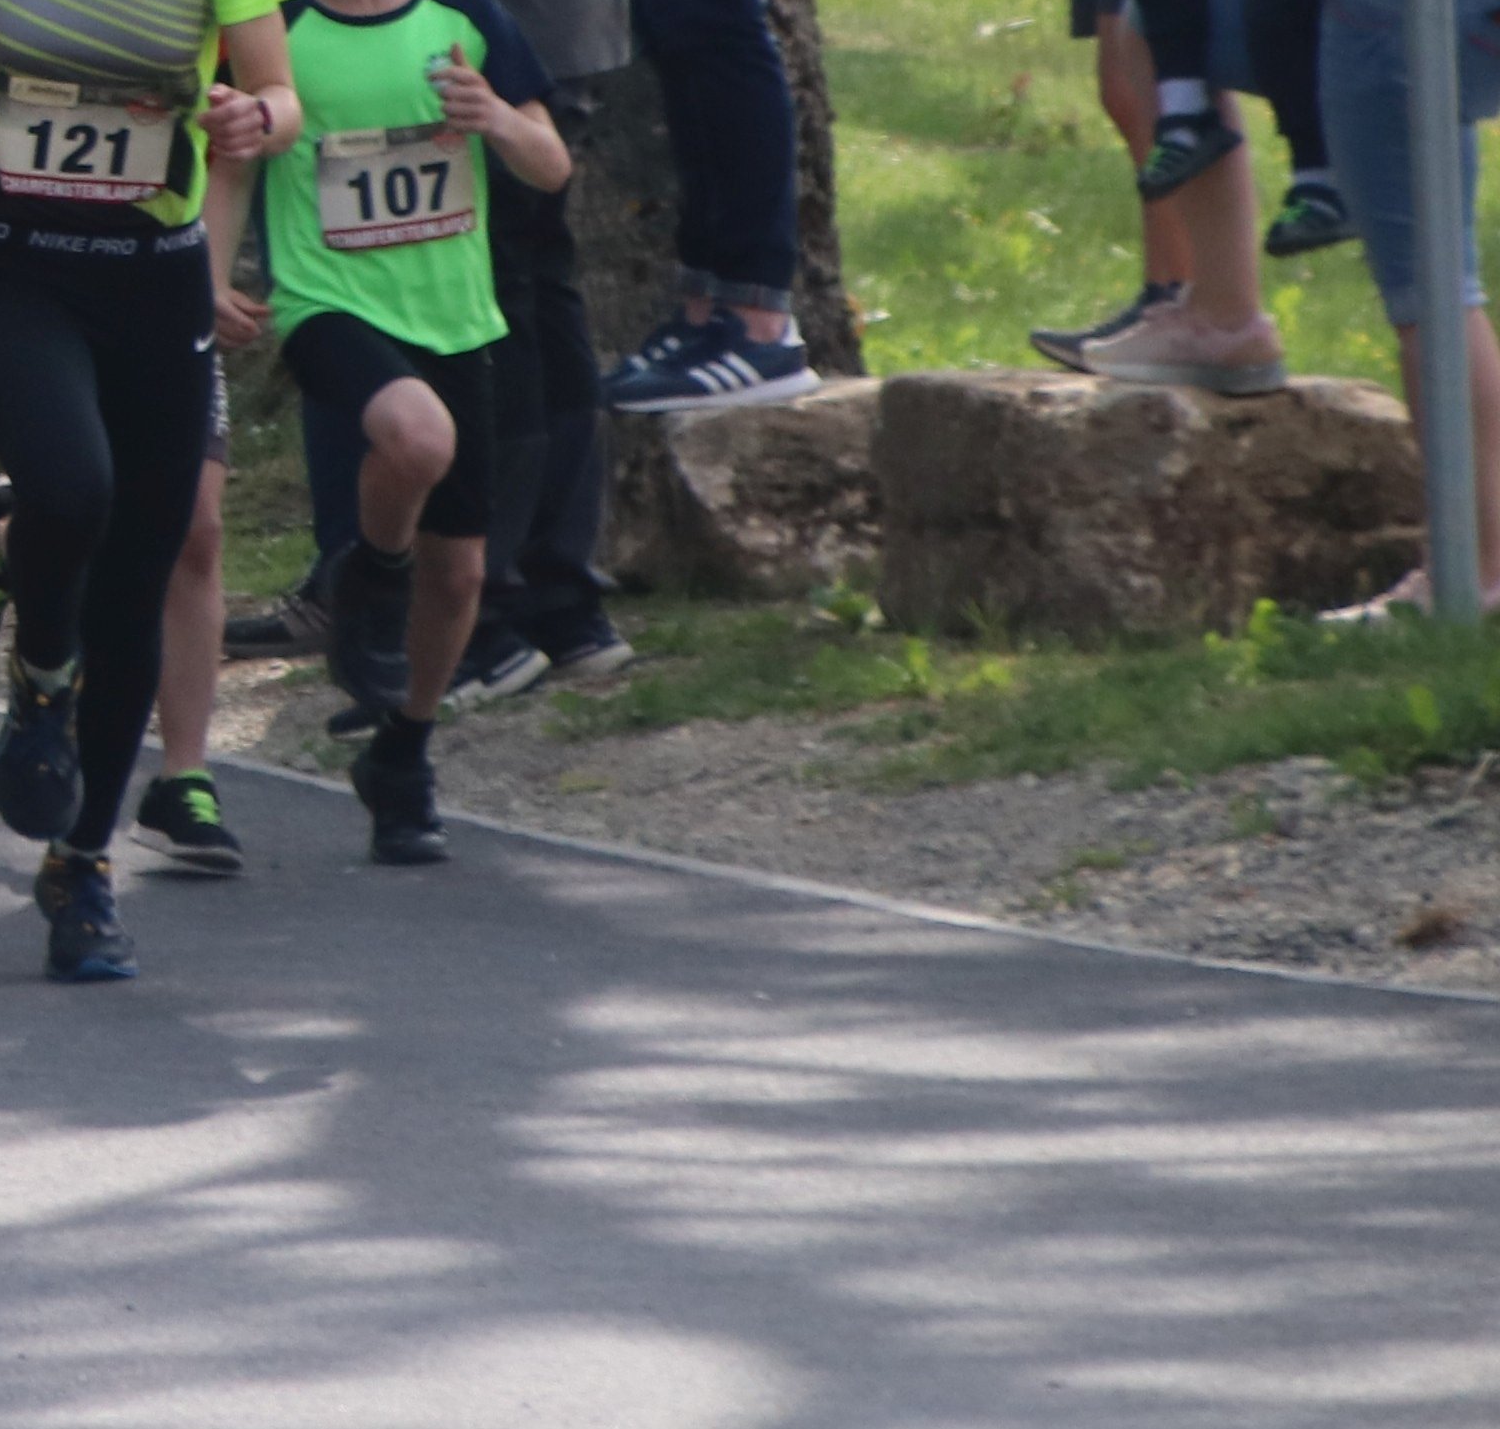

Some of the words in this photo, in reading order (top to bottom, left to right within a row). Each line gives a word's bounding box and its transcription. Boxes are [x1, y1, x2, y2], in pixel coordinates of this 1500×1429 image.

[27, 119, 131, 176] 121
[348, 160, 449, 220] 107
[28, 230, 85, 253] NIKE
[89, 237, 138, 255] PRO
